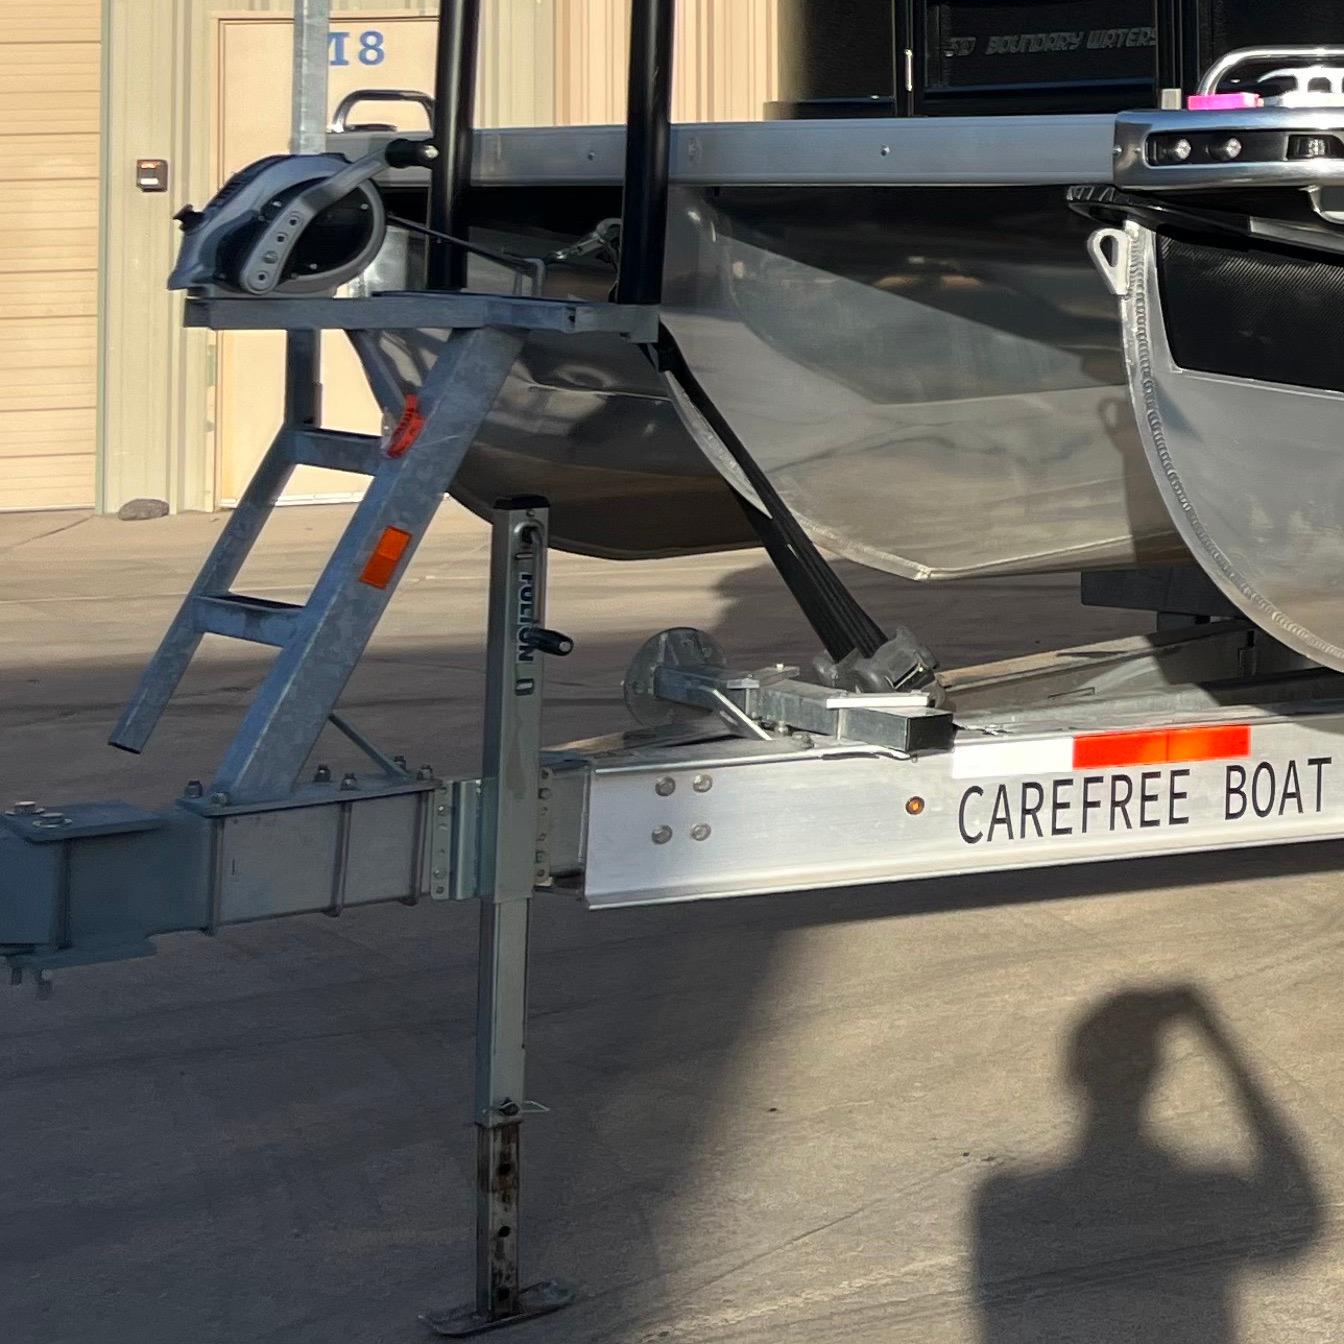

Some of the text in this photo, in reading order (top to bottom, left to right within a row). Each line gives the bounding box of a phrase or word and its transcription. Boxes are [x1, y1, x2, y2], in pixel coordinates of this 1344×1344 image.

[985, 31, 1085, 55] BOUNDARY
[957, 767, 1191, 845] CAREFREE
[1224, 756, 1333, 820] BOAT
